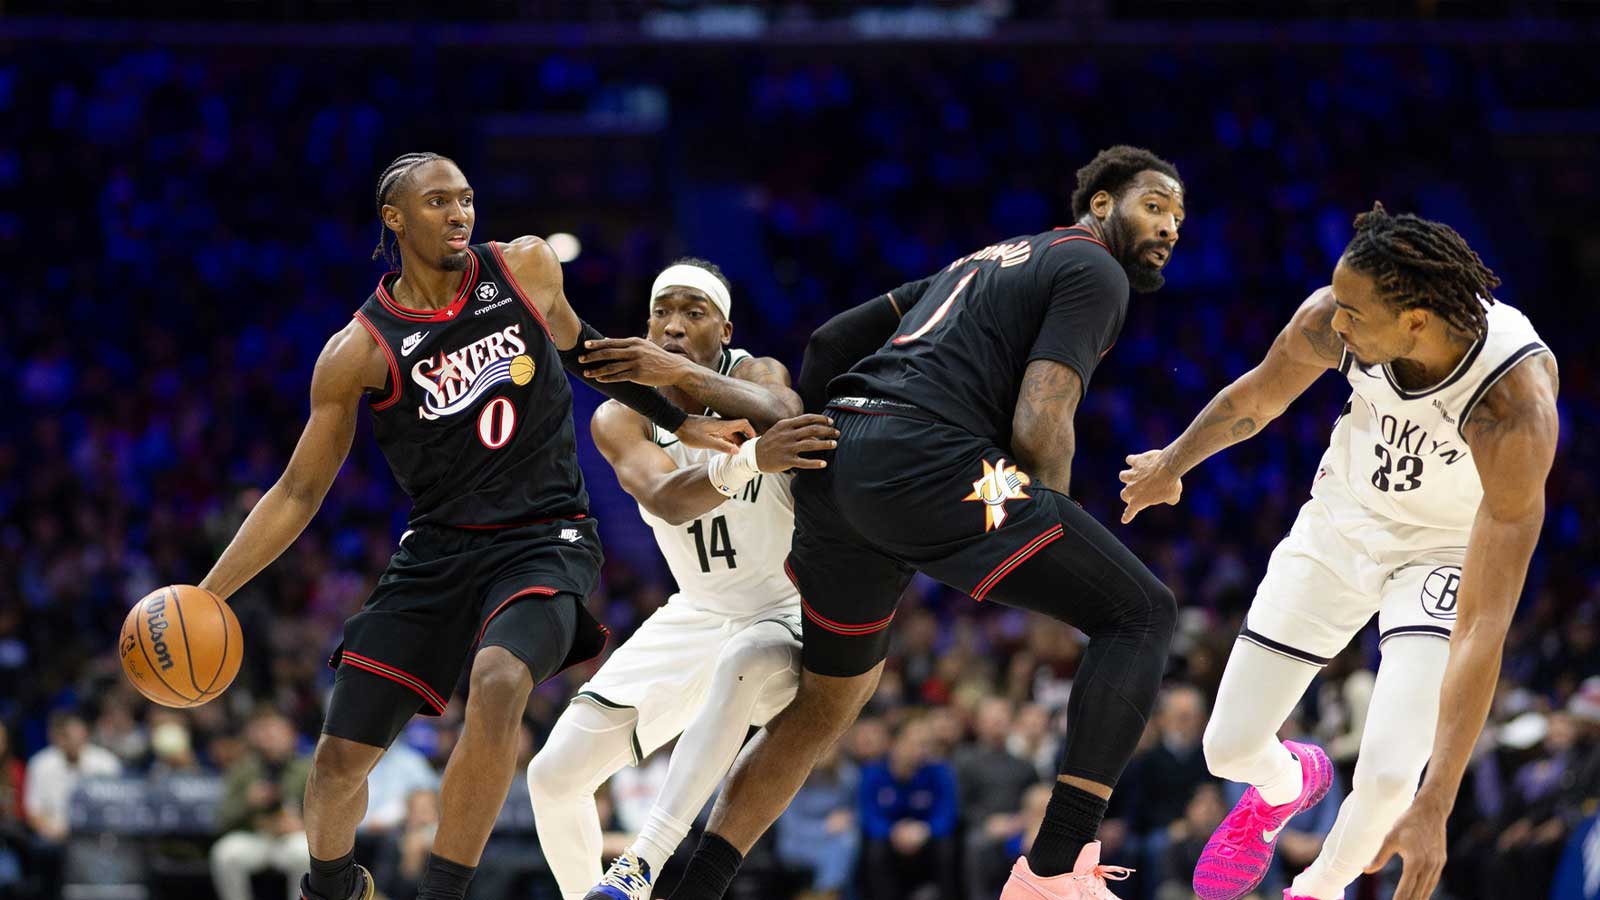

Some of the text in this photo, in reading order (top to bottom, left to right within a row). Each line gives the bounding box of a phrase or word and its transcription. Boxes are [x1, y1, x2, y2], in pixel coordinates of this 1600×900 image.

[474, 296, 513, 316] crypto.com
[402, 331, 422, 349] NIKE
[477, 396, 517, 450] 0
[1371, 403, 1467, 466] OKLYN
[687, 515, 737, 573] 14
[146, 594, 174, 673] Wilson
